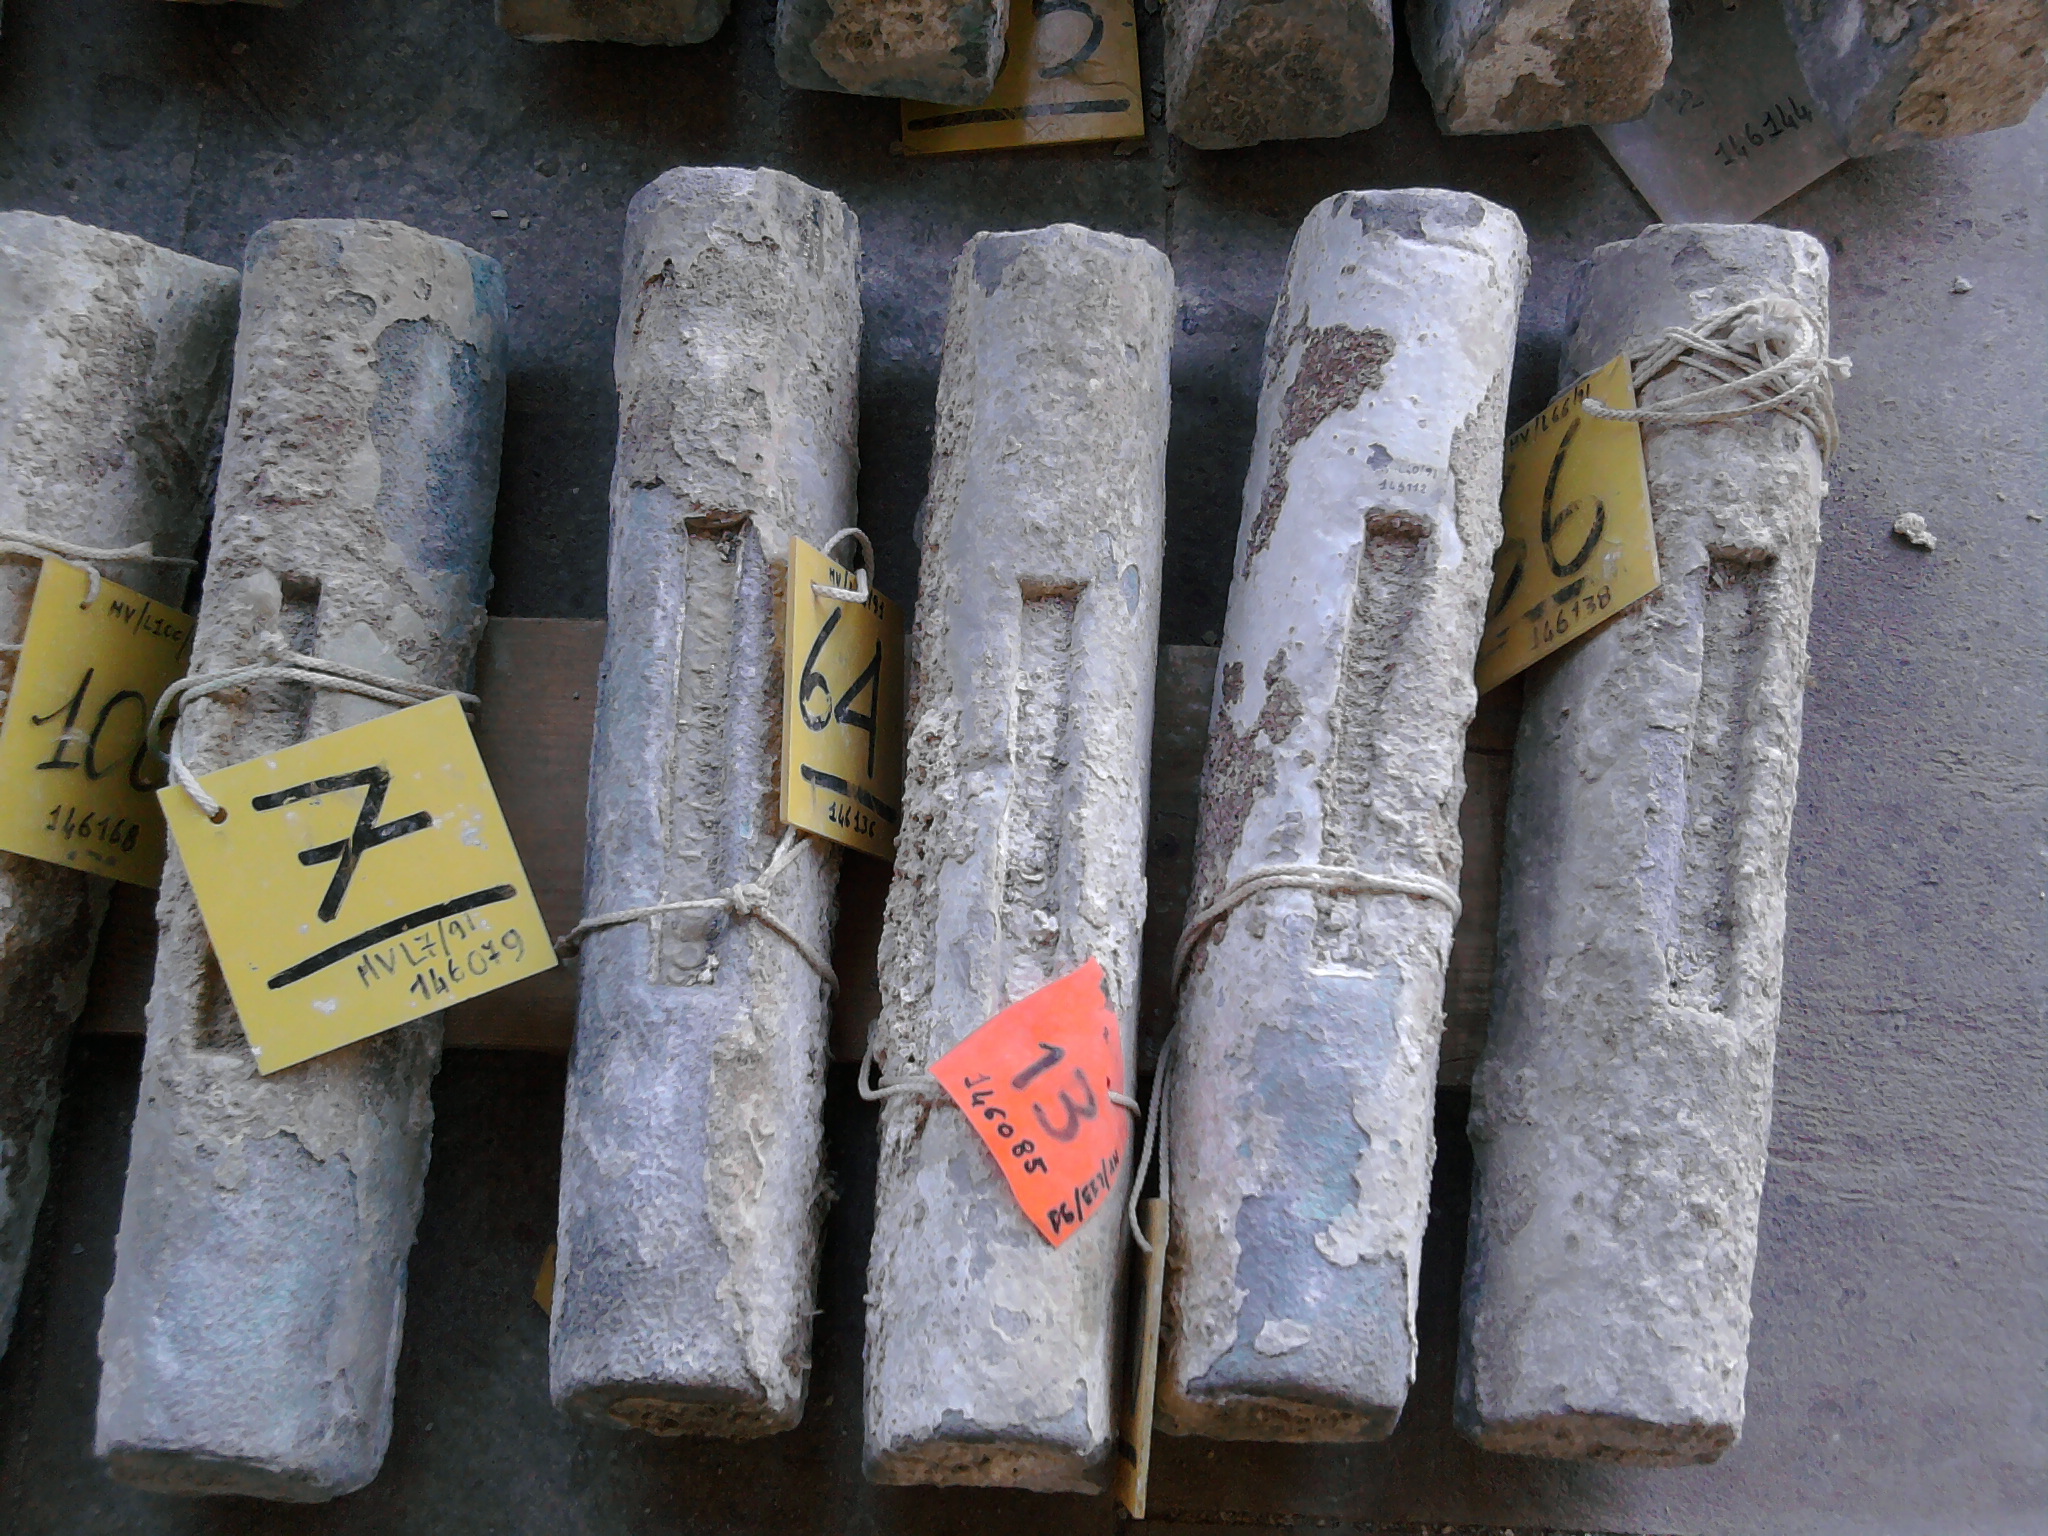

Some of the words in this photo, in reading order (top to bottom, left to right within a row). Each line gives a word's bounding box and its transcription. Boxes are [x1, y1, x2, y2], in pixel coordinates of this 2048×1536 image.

[1714, 96, 1813, 166] 146144
[799, 605, 882, 779] 64
[251, 764, 433, 923] 7
[410, 927, 526, 1002] 146079
[964, 1073, 1048, 1175] 146085
[1010, 1040, 1098, 1143] 13
